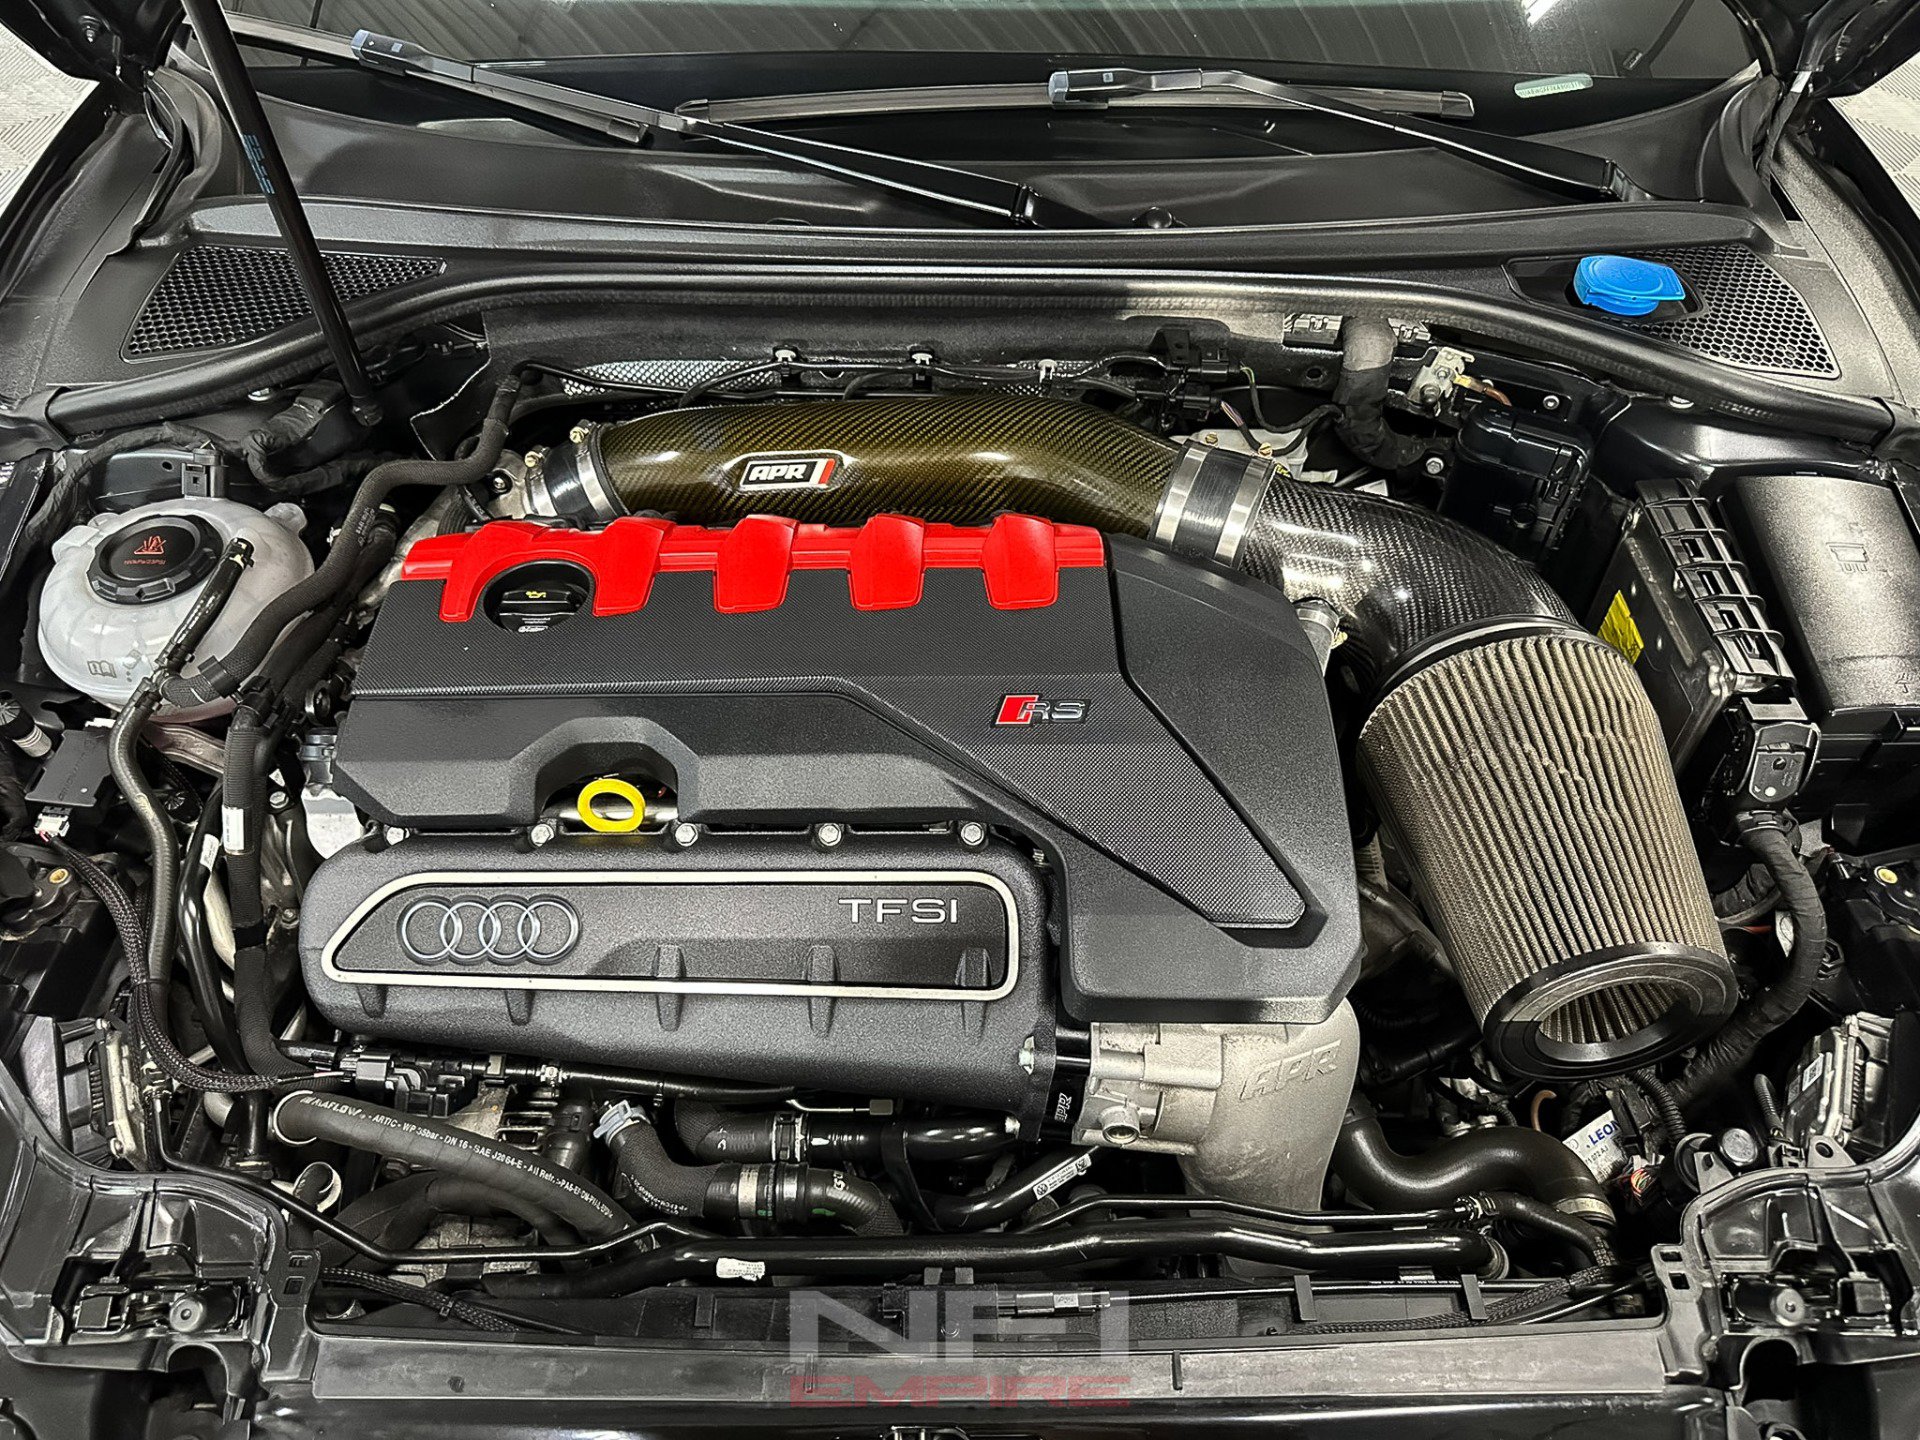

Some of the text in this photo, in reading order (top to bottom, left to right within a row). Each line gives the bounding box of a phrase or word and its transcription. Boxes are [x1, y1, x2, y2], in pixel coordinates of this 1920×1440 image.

[748, 464, 807, 481] APR
[1015, 699, 1086, 723] RS
[838, 898, 958, 924] TFSI
[1239, 1039, 1342, 1101] APR
[443, 1134, 458, 1146] DN
[458, 1139, 469, 1150] 16
[474, 1144, 492, 1158] SAE
